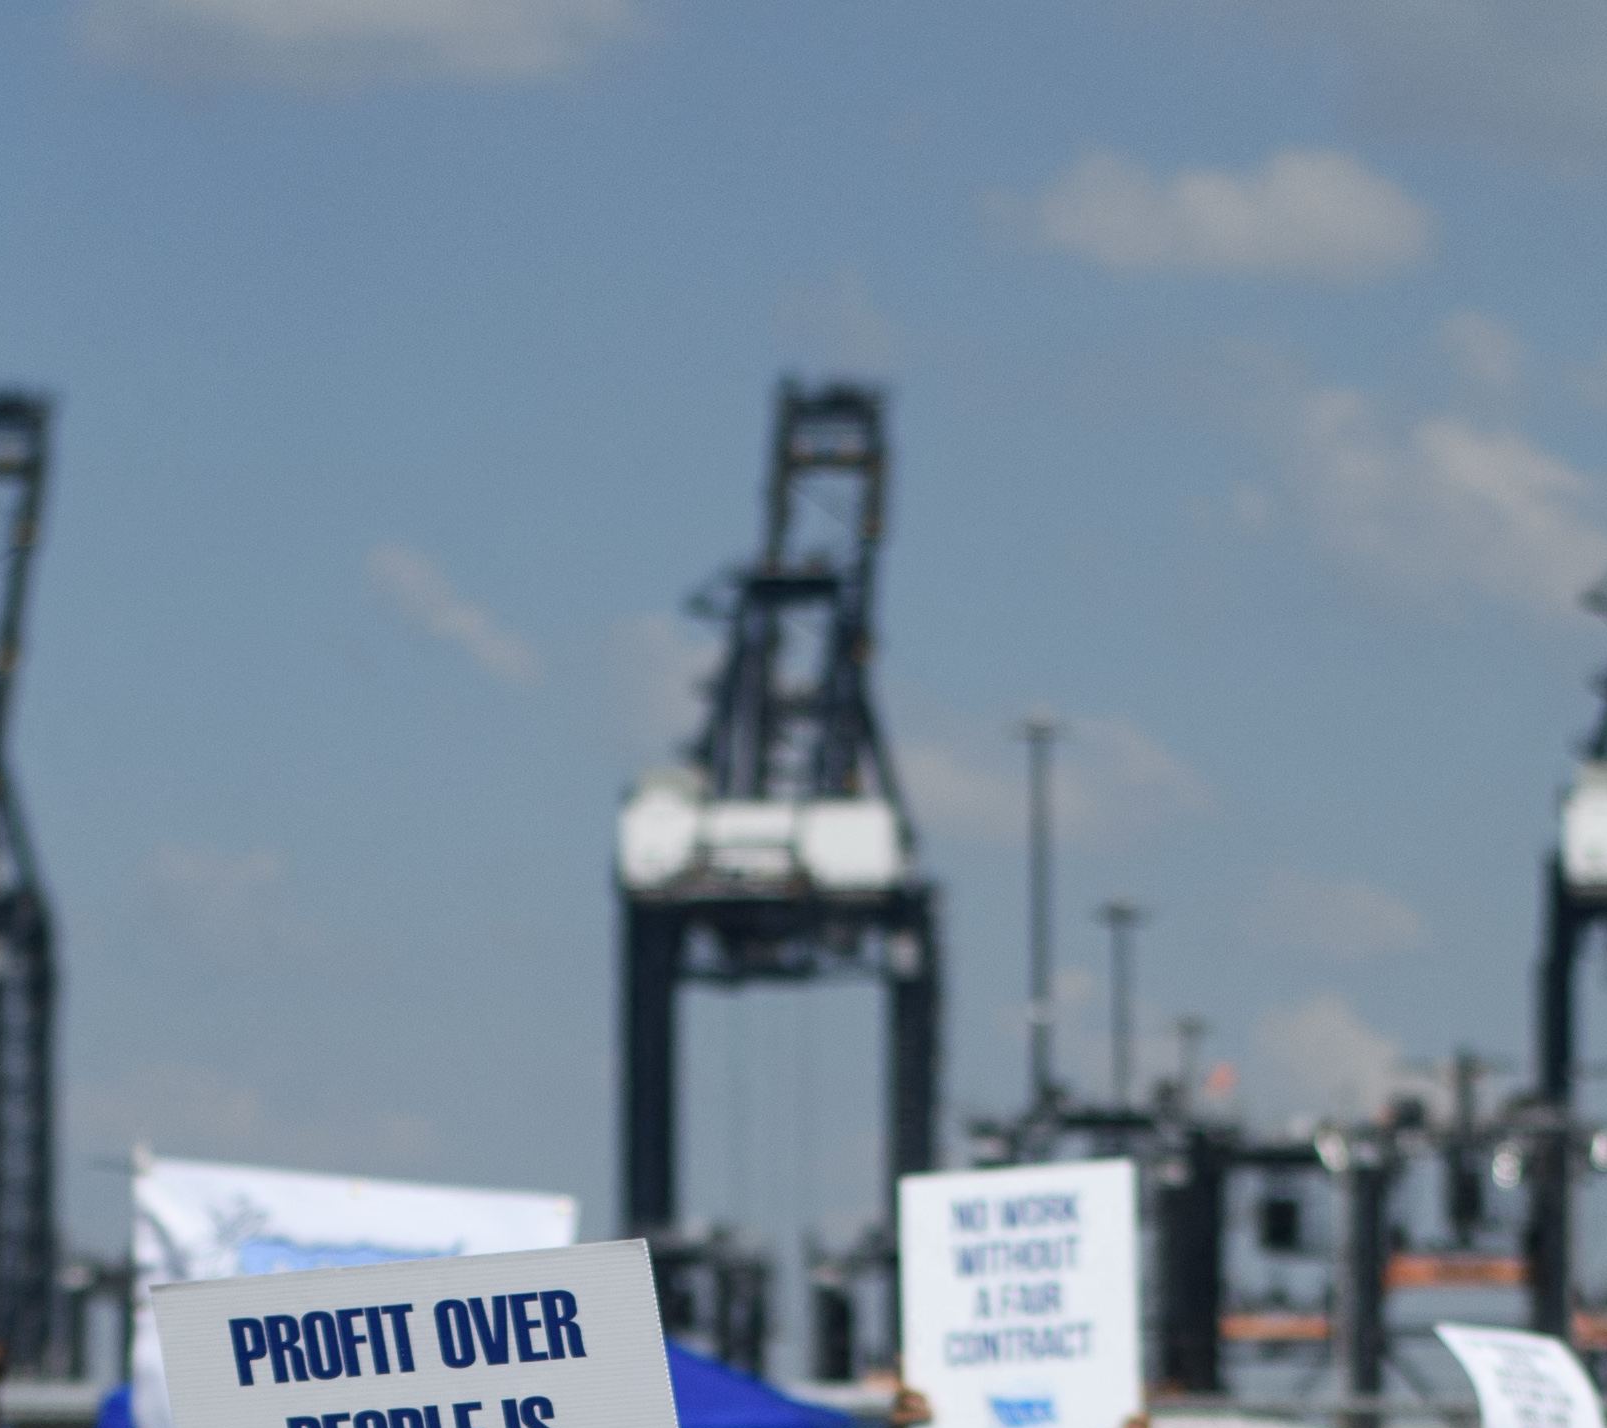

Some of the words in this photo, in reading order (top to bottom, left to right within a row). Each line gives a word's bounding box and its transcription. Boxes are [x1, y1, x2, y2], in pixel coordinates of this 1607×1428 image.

[951, 1199, 988, 1232] NO
[1000, 1191, 1079, 1230] WORK
[950, 1233, 1079, 1279] WITHOUT
[975, 1284, 991, 1320] A
[999, 1280, 1063, 1316] FAIR
[228, 1302, 416, 1388] PROFIT
[432, 1288, 588, 1370] OVER
[944, 1321, 1093, 1368] CONTRACT
